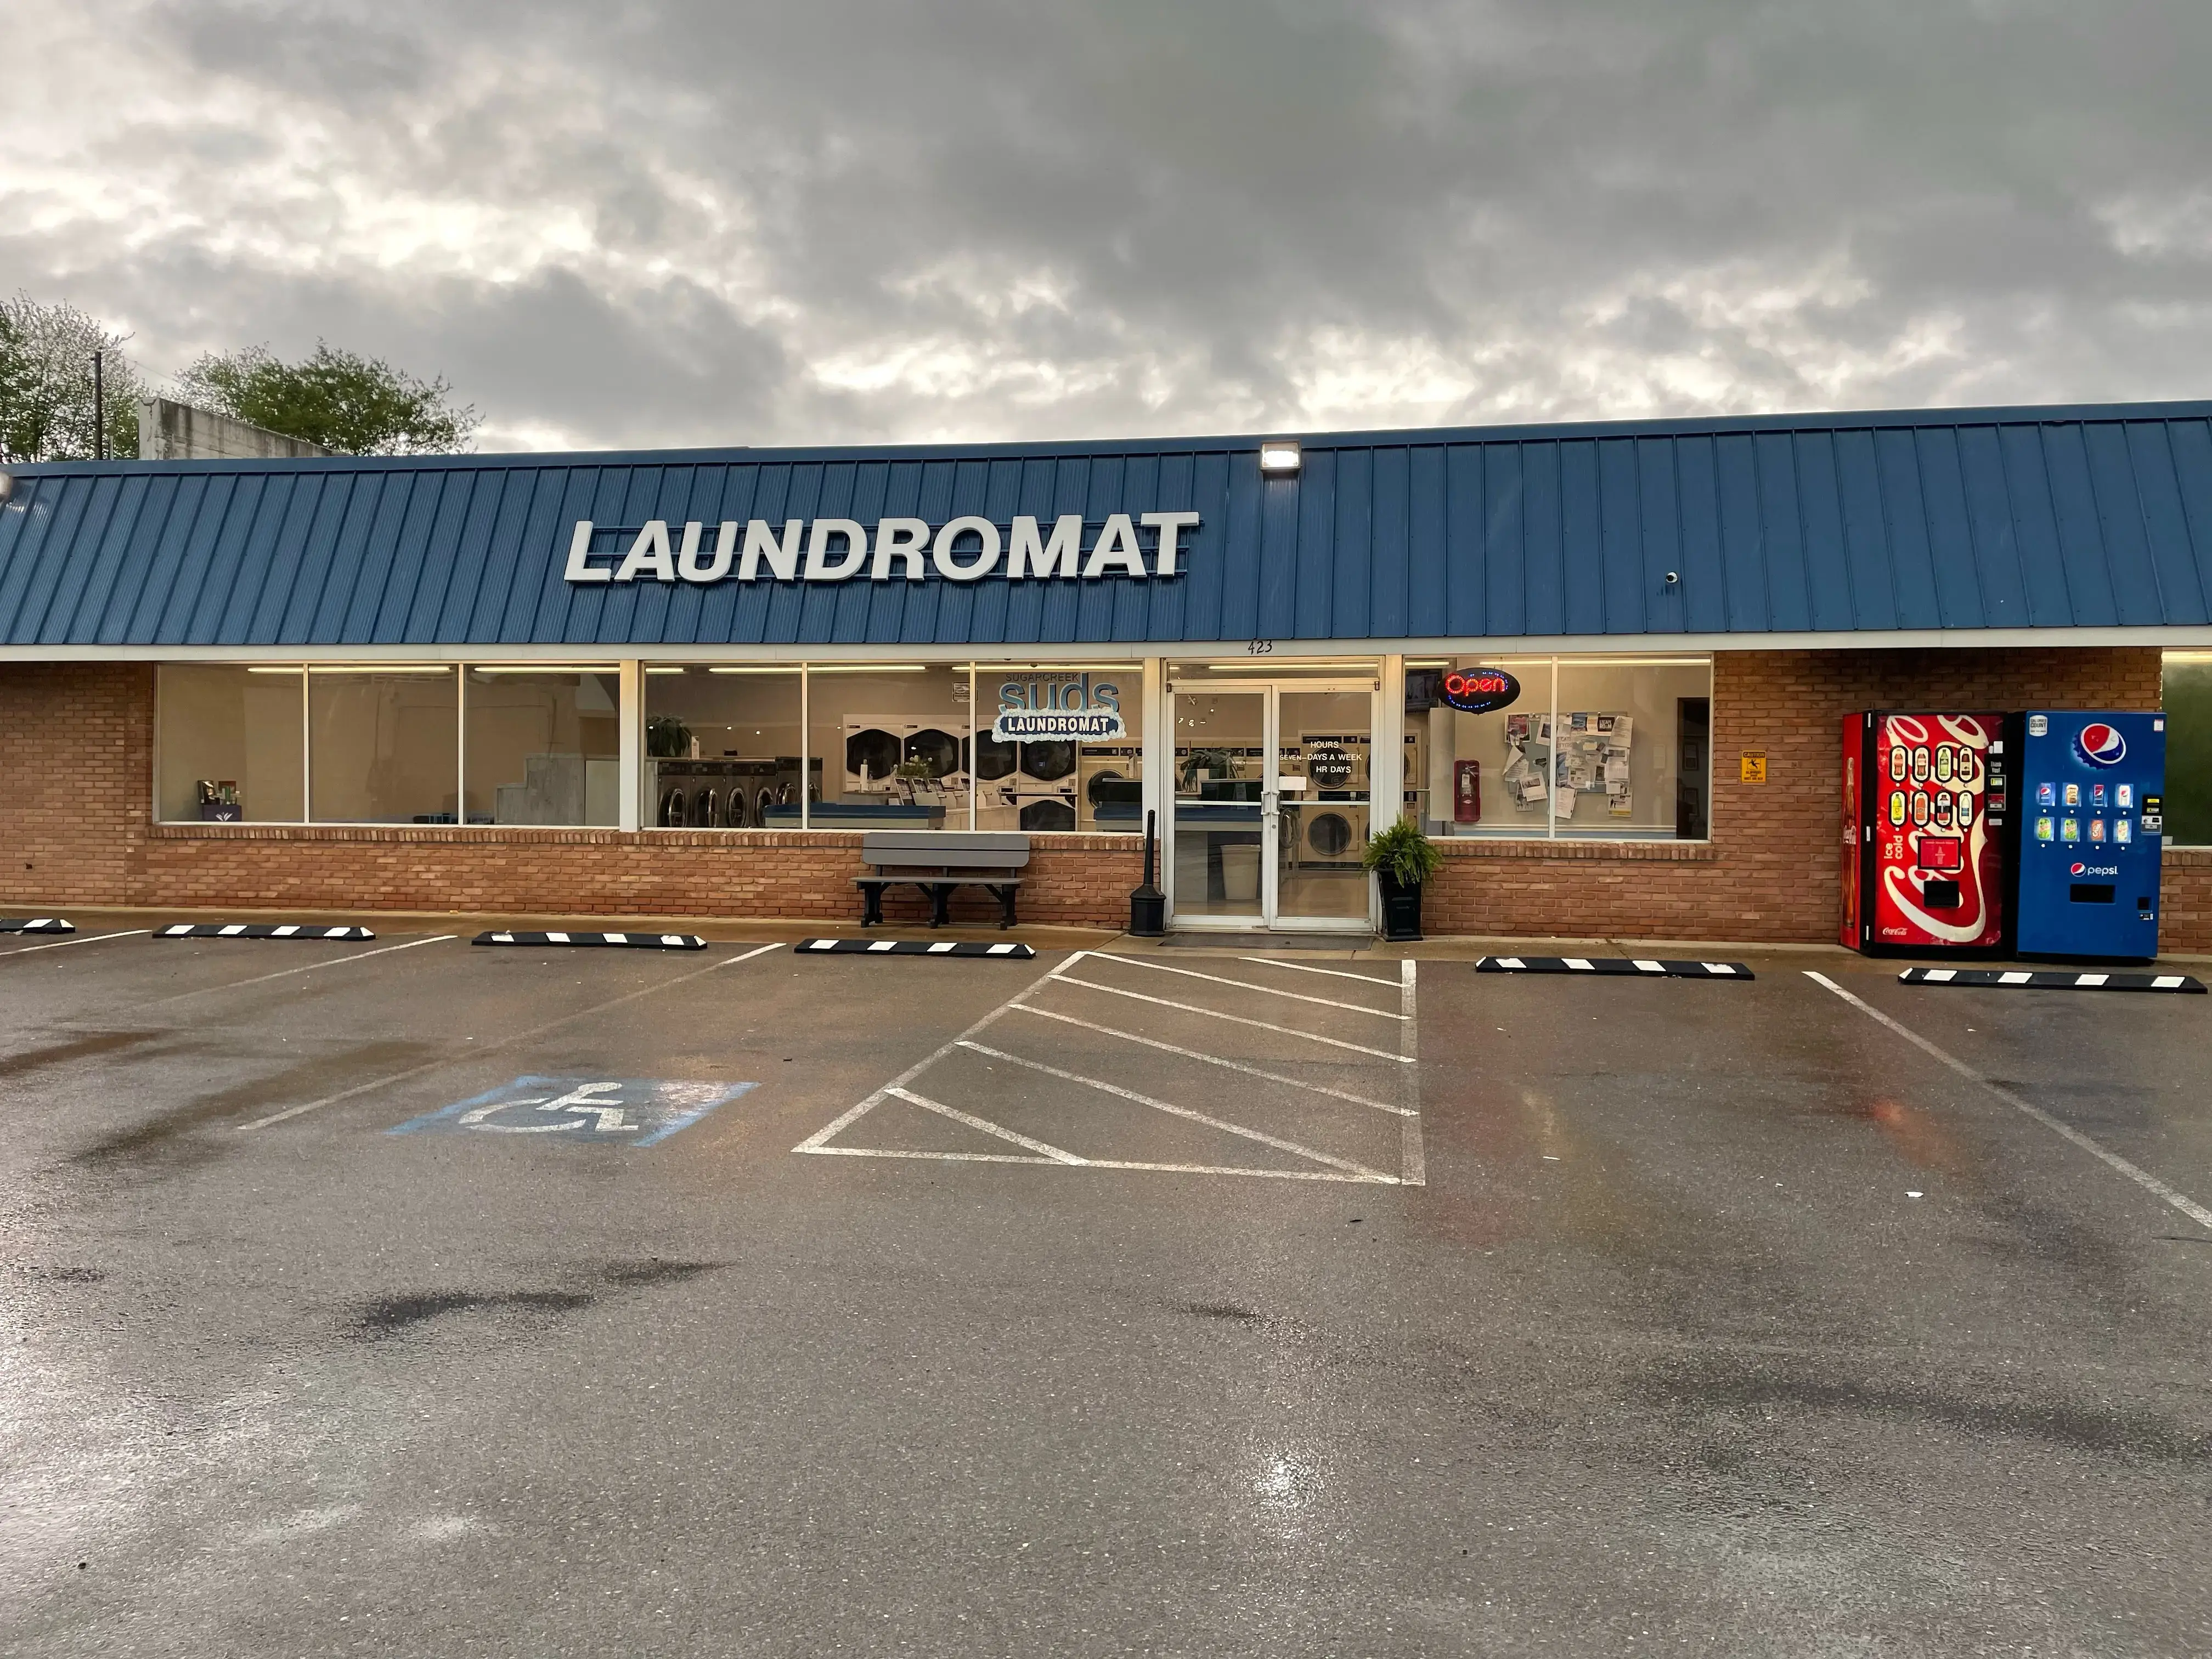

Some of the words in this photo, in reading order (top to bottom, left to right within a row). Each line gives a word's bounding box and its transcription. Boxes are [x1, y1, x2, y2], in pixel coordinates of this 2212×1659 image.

[564, 512, 1200, 582] LAUNDROMAT
[1248, 639, 1272, 655] 423
[1006, 673, 1079, 681] SUGARCREEK
[998, 672, 1119, 713] suds
[1446, 674, 1505, 697] Open
[1008, 718, 1109, 731] LAUNDROMAT
[1883, 843, 1893, 859] Ice
[1893, 835, 1903, 860] cold
[2087, 866, 2118, 876] pepsi
